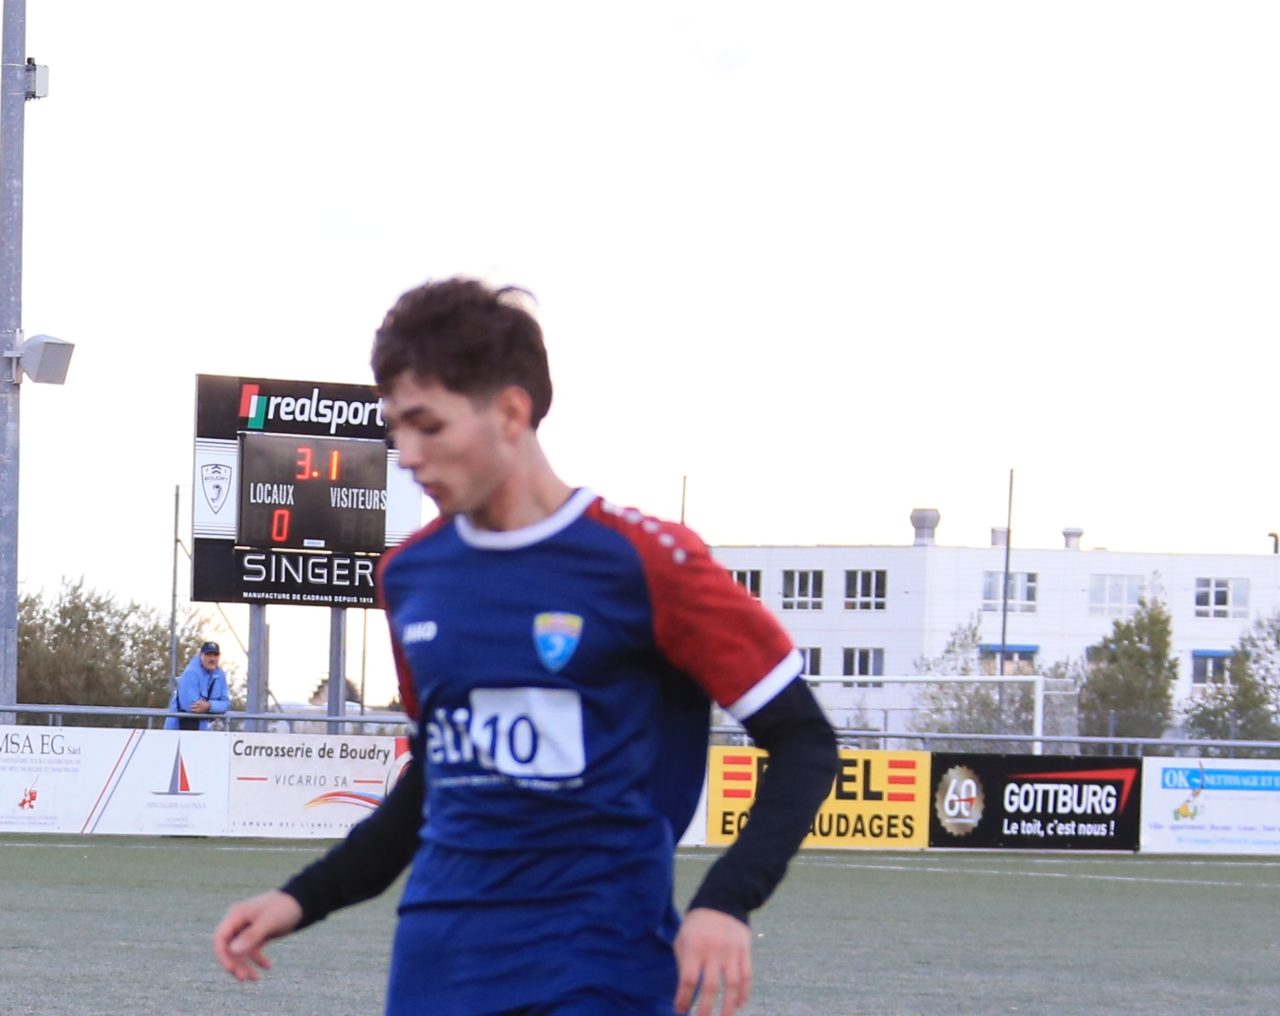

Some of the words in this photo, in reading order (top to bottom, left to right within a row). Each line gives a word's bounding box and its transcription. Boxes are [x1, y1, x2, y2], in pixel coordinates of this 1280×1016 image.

[267, 387, 384, 435] realsport
[250, 482, 295, 506] LOCAUX
[329, 486, 387, 510] VISITEURS
[271, 508, 291, 542] 0
[243, 553, 375, 588] SINGER
[242, 591, 290, 600] MANUFACTURE
[292, 593, 301, 601] DE
[302, 594, 333, 602] CADRANS
[333, 595, 358, 603] DEPUIS
[40, 733, 66, 756] EG
[232, 739, 313, 758] Carrosserie
[318, 742, 334, 759] de
[339, 743, 391, 765] Boudry
[275, 774, 327, 787] VICARIO
[334, 775, 348, 787] SA
[1165, 769, 1190, 788] OK
[1003, 782, 1117, 816] GOTTBURG
[1003, 818, 1017, 834] Le
[1020, 819, 1045, 838] toit,
[1046, 819, 1076, 836] c'est
[1078, 822, 1107, 836] nous
[1109, 821, 1115, 837] !
